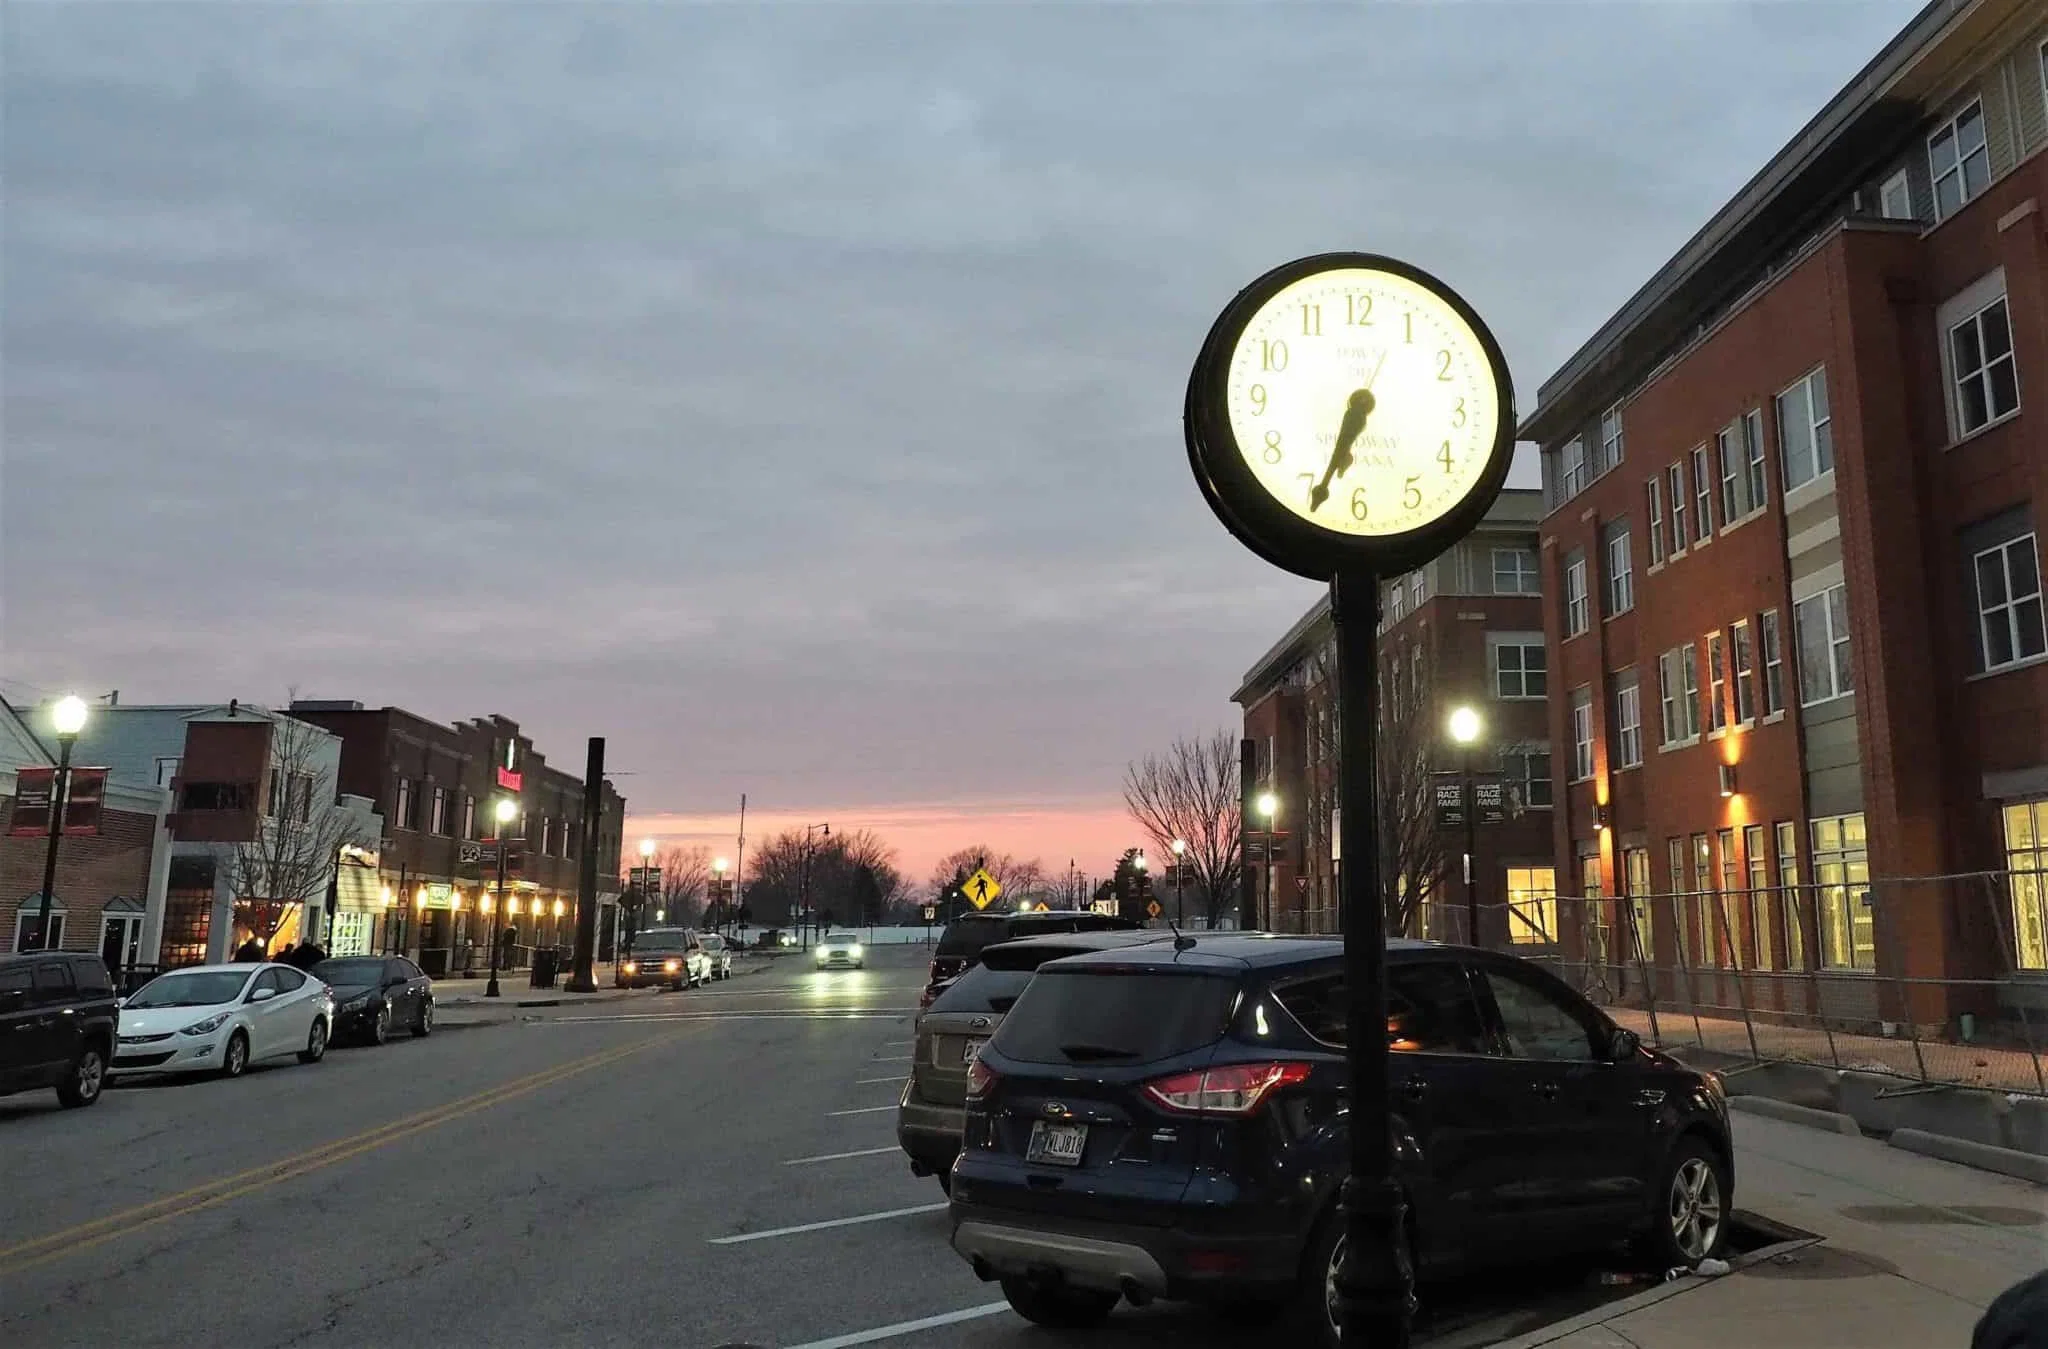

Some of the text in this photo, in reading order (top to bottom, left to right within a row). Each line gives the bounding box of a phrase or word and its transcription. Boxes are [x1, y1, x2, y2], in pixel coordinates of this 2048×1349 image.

[1300, 303, 1322, 337] 11
[1344, 294, 1374, 327] 12
[1403, 311, 1413, 345] 1
[1260, 339, 1289, 373] 10
[1436, 349, 1455, 382] 2
[1249, 384, 1268, 417] 9
[1452, 397, 1467, 429] 3
[1263, 430, 1283, 465] 8
[1436, 440, 1456, 475] 4
[1296, 472, 1316, 510] 7
[1350, 487, 1368, 521] 6
[1403, 474, 1422, 510] 5
[1437, 790, 1461, 799] RACE
[1477, 789, 1502, 798] RACE
